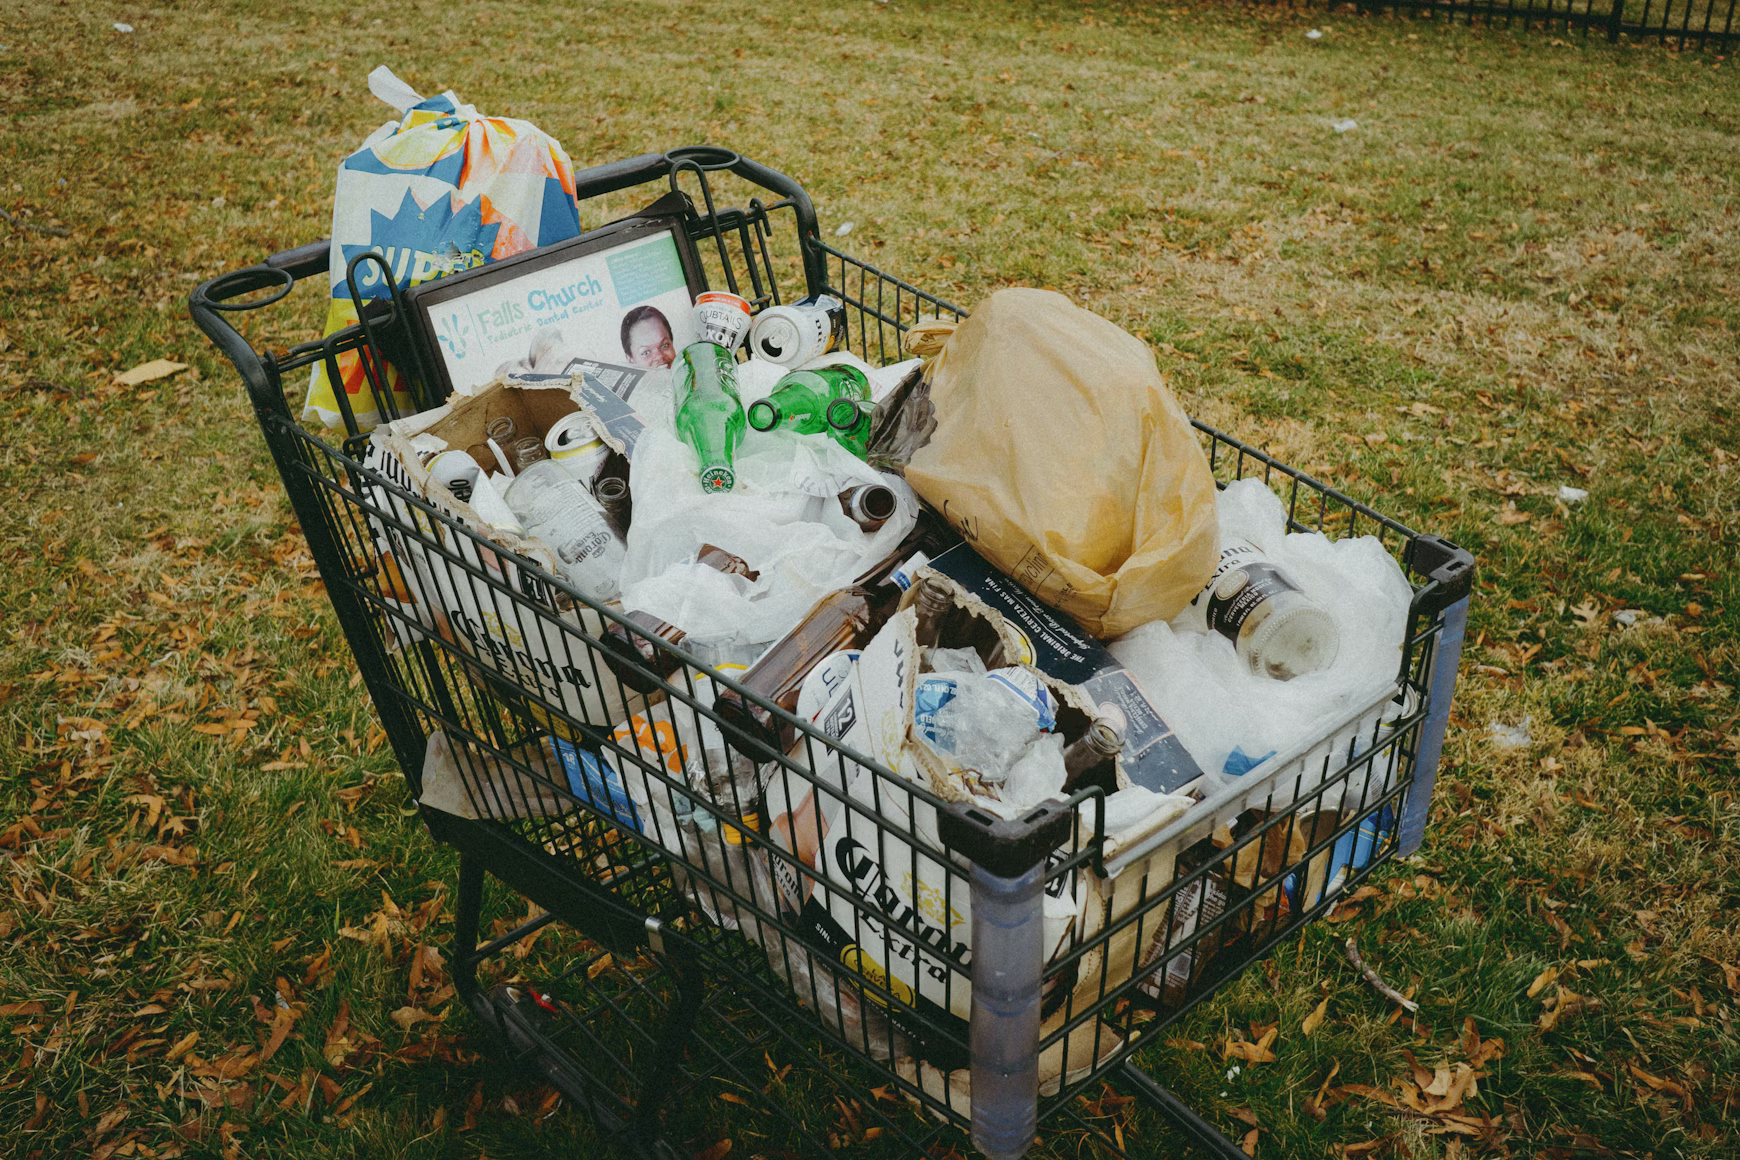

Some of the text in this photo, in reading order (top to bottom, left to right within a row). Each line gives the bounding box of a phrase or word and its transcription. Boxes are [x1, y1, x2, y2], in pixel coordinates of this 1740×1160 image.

[477, 300, 524, 334] Falls
[527, 274, 602, 312] Church
[487, 298, 604, 345] Pediatric Dental Center
[702, 470, 733, 485] Heineken
[575, 531, 611, 563] Corona
[985, 577, 1002, 593] FINA
[1000, 591, 1015, 606] MAS
[1012, 604, 1044, 634] CERVEZA
[1070, 650, 1085, 666] THE
[837, 697, 854, 731] 12
